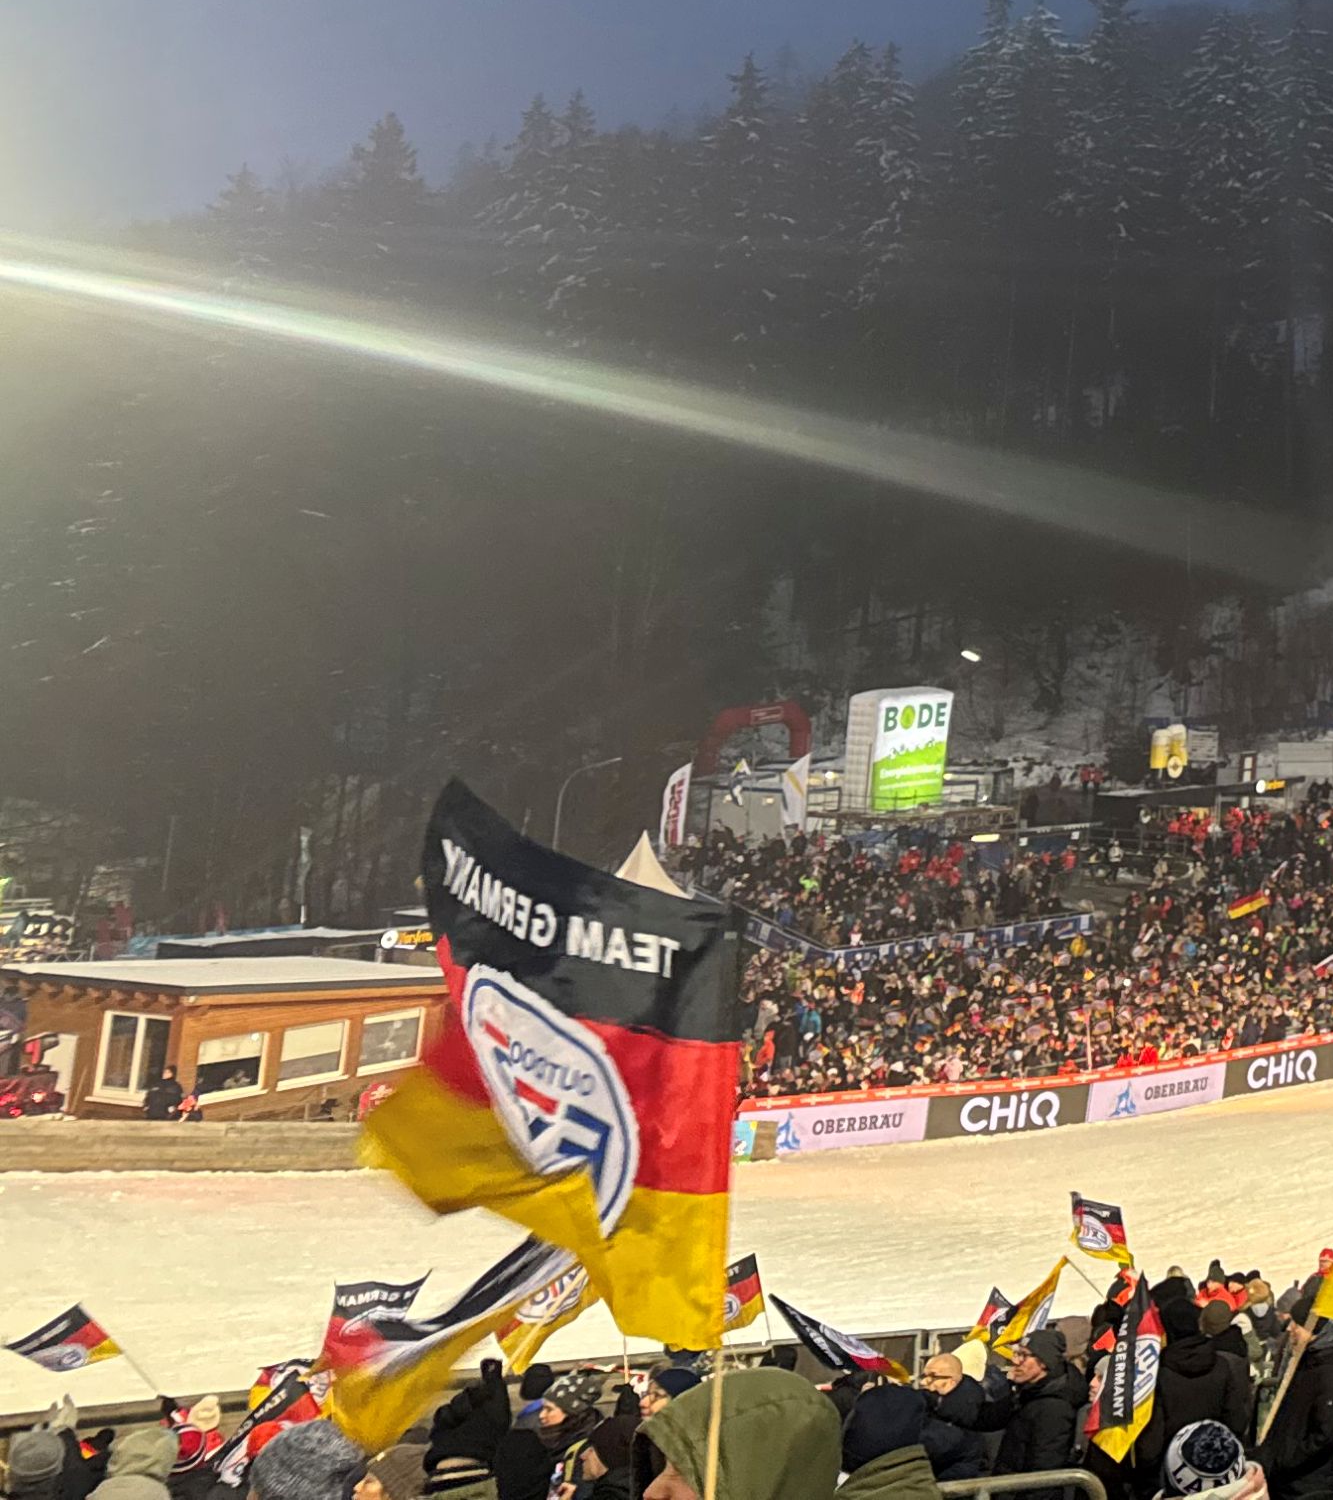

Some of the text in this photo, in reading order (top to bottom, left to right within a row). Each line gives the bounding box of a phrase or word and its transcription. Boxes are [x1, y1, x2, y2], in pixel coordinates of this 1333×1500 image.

[883, 702, 948, 732] BODE
[1144, 1076, 1210, 1101] OBERBRÄU
[811, 1111, 905, 1136] OBERBRÄU
[1112, 1341, 1128, 1418] GERMANY
